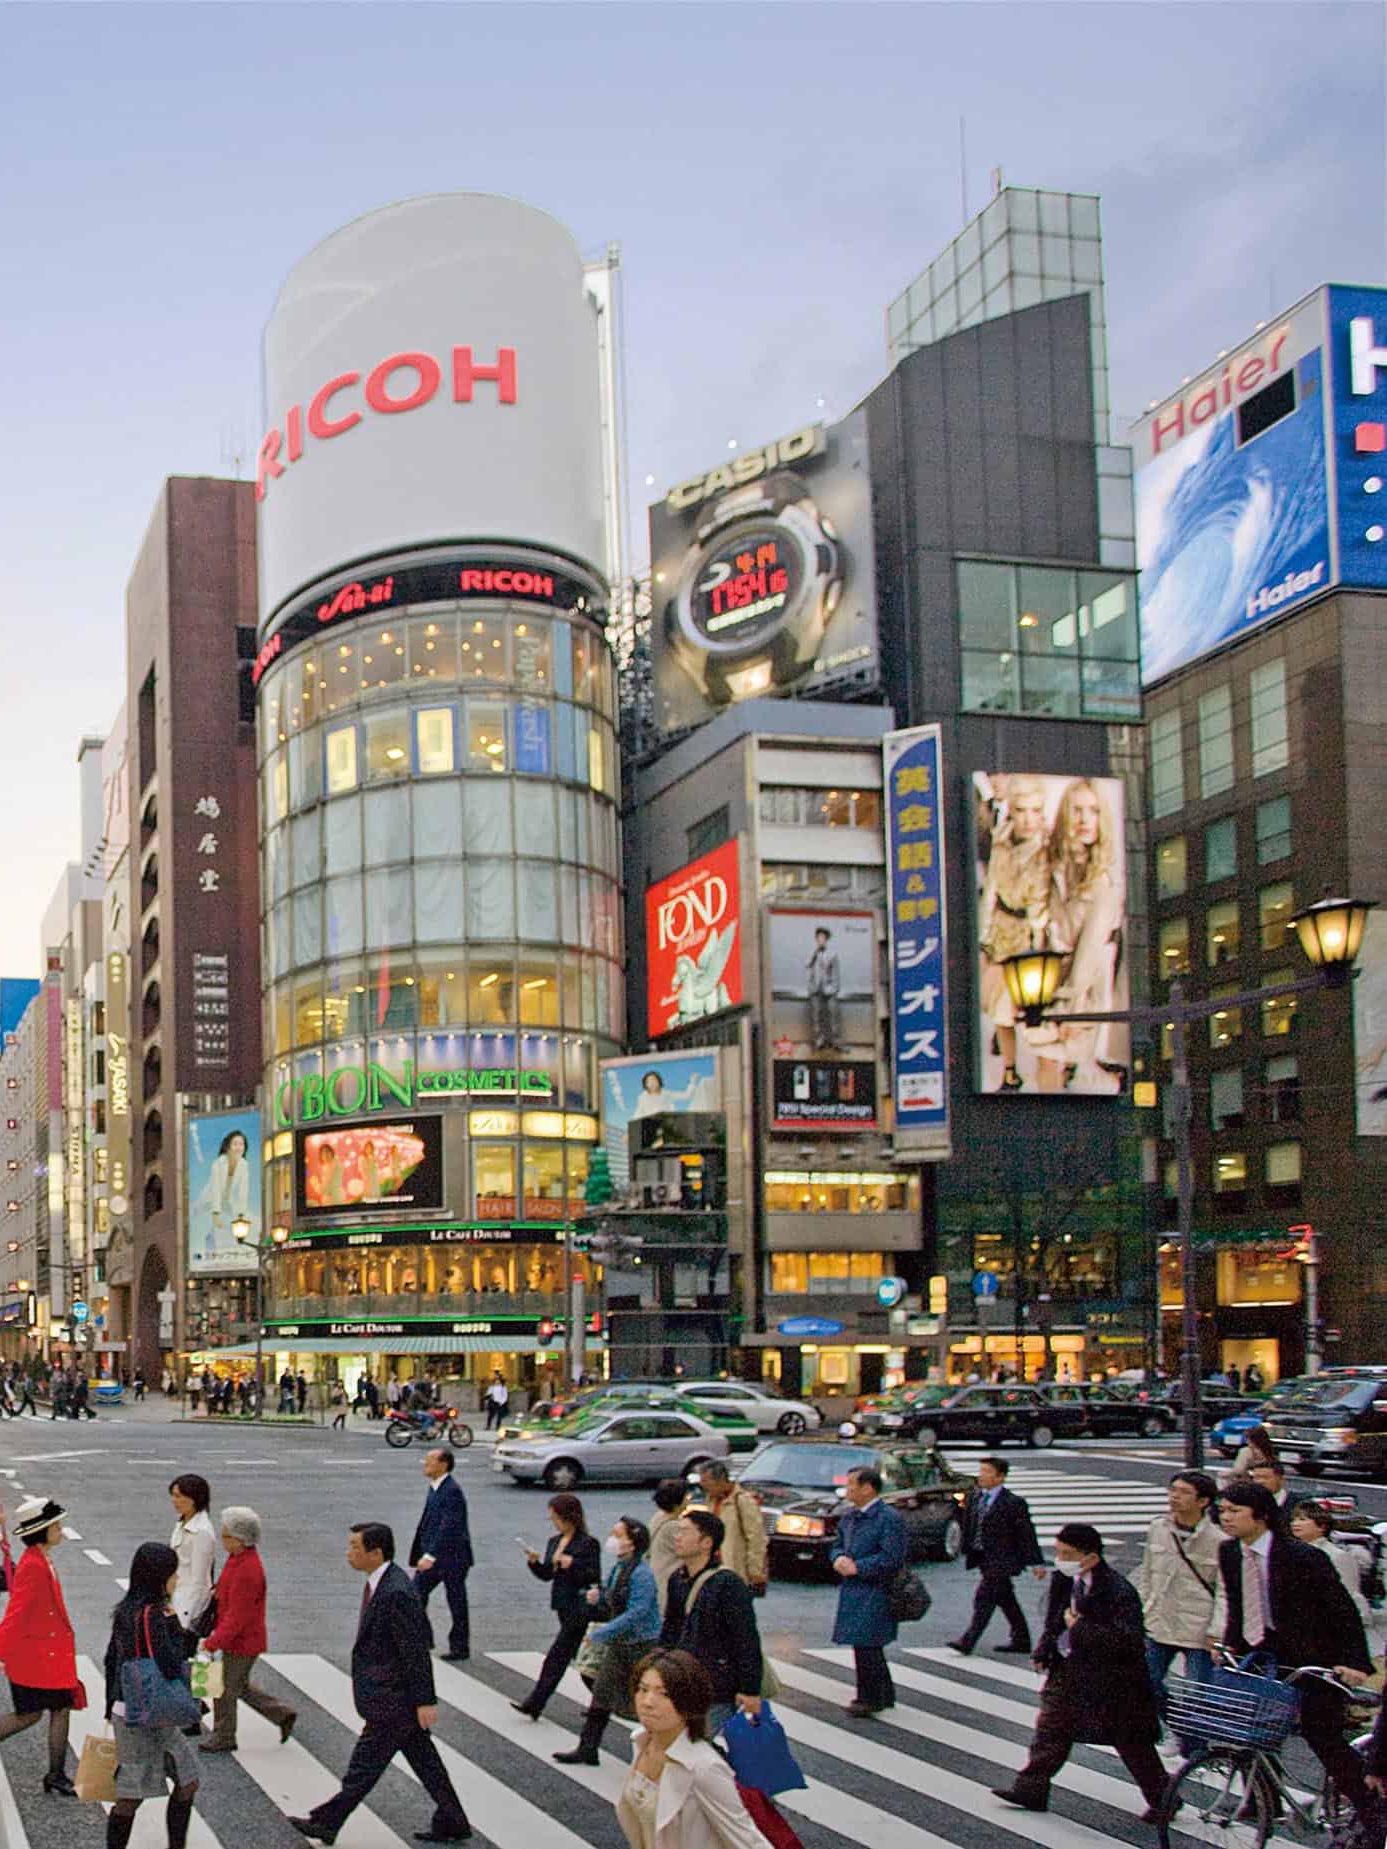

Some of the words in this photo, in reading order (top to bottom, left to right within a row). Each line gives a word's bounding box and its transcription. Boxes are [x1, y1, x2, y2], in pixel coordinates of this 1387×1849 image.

[255, 345, 517, 502] RICOH
[1150, 334, 1289, 455] Haier
[667, 427, 821, 510] CASIO
[461, 569, 554, 597] RICOH
[1246, 562, 1325, 618] Haier
[897, 937, 941, 1061] ジオス
[417, 1068, 553, 1092] COSMETICS
